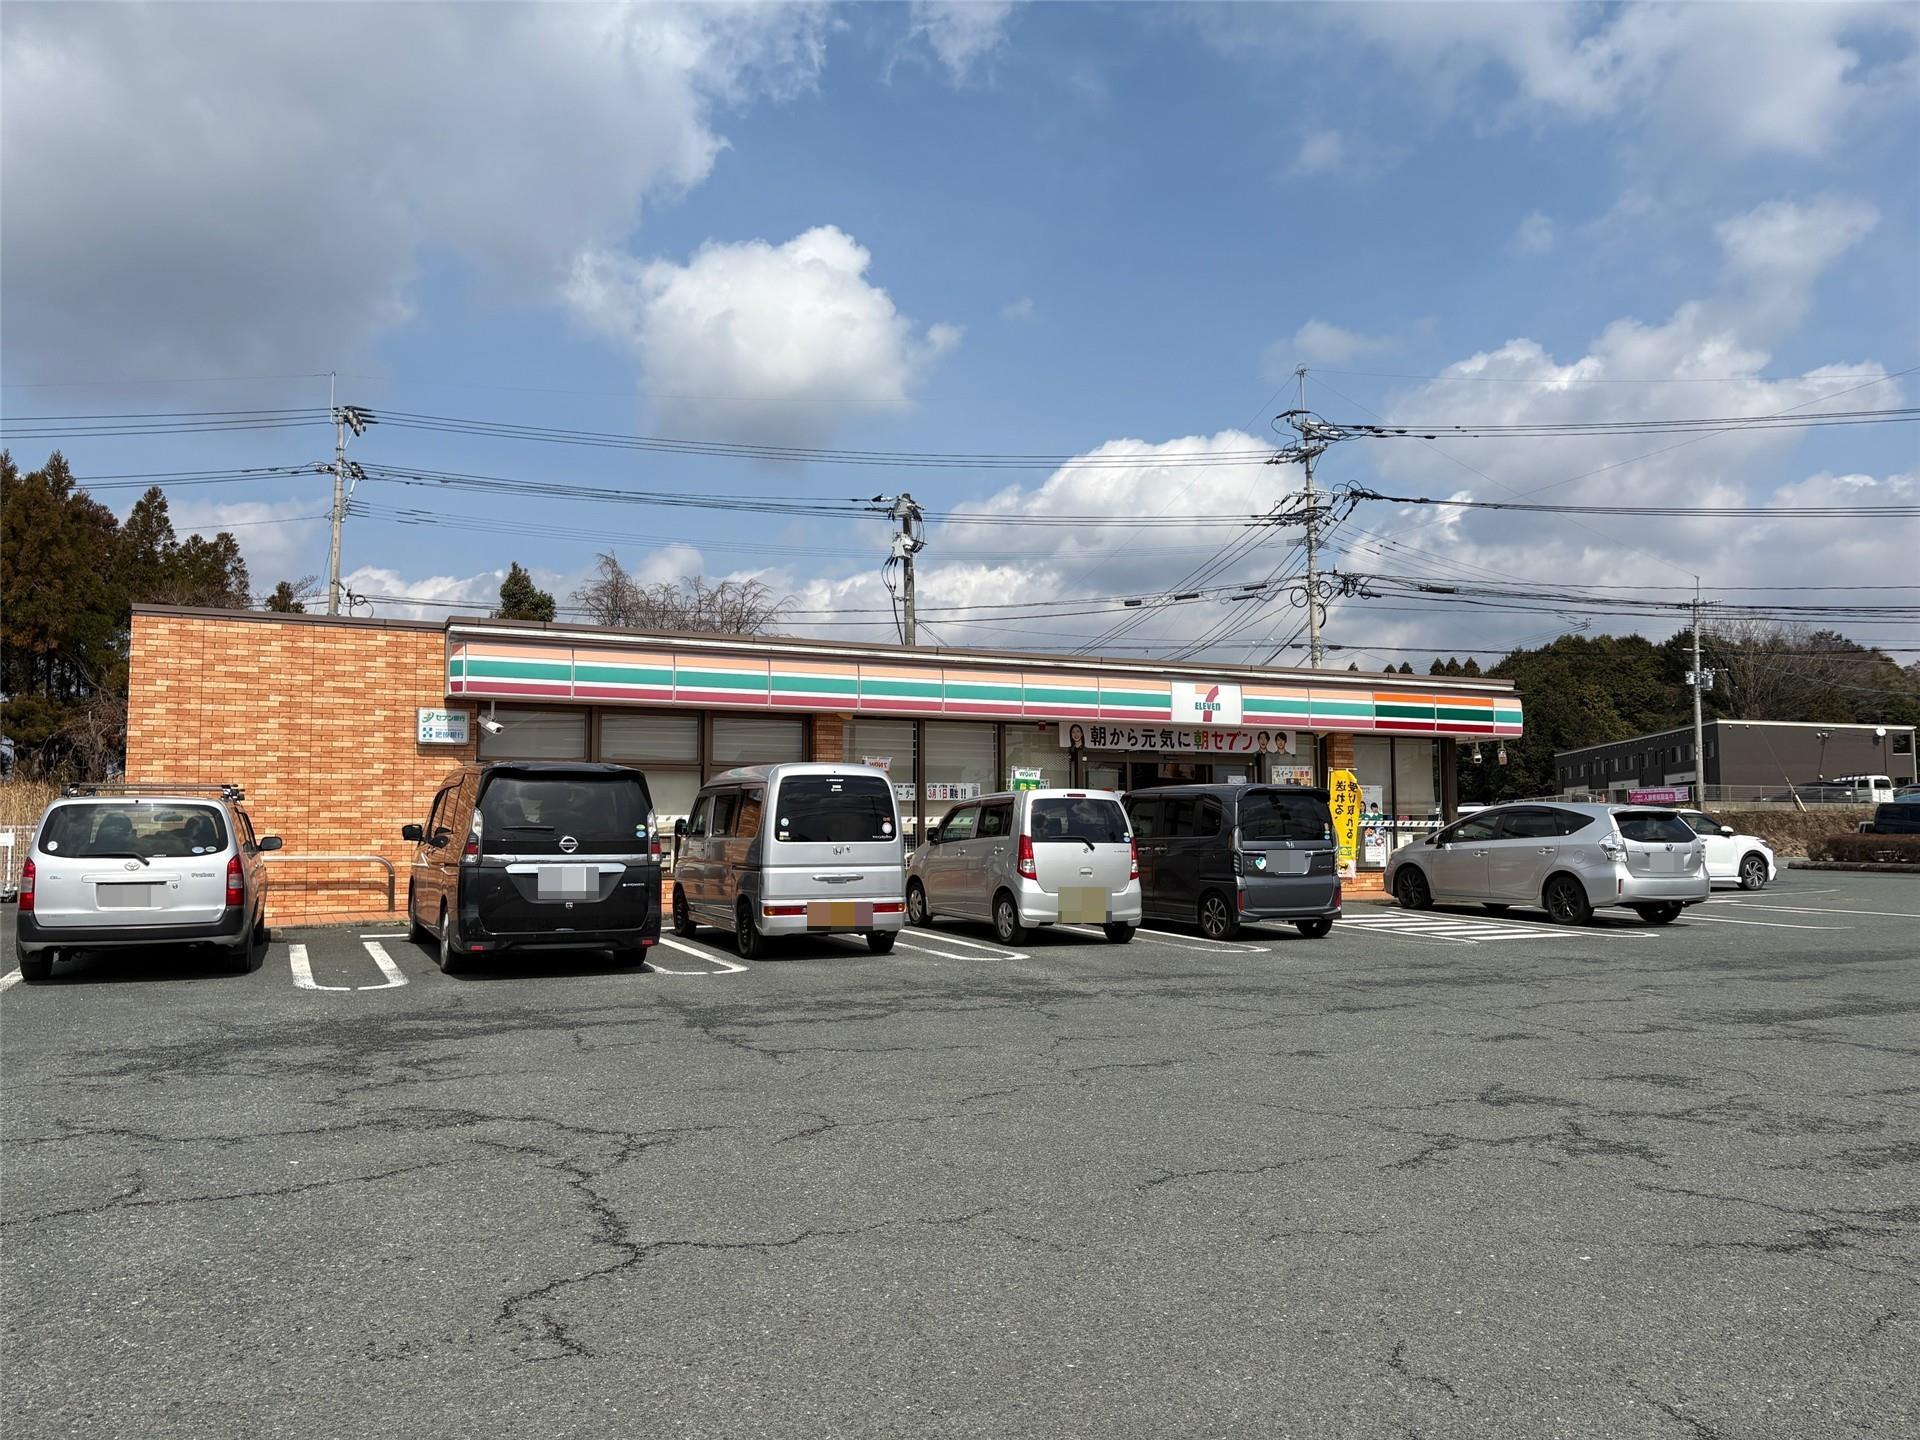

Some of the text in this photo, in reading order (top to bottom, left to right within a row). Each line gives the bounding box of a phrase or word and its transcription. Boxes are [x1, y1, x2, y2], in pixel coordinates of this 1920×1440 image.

[1195, 685, 1219, 722] 7
[435, 714, 466, 722] セブン銀行
